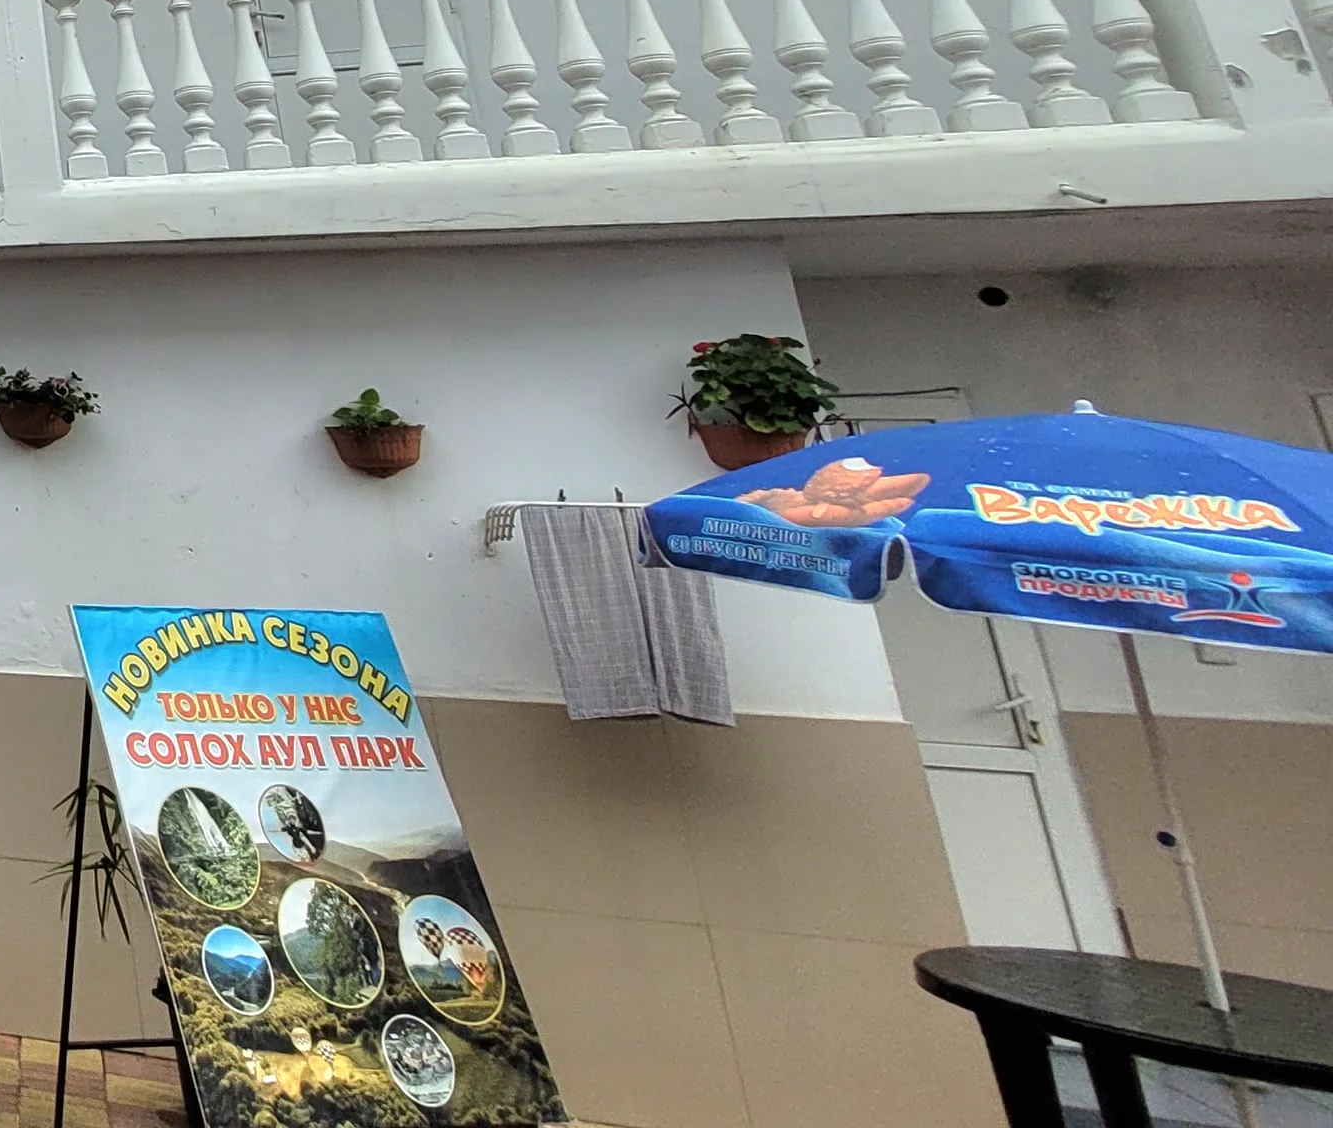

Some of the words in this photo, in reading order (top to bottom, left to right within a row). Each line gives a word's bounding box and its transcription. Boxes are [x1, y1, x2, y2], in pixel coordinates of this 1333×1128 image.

[966, 483, 1301, 536] Варежка
[693, 537, 765, 563] ВКУСОМ
[1011, 562, 1186, 592] ЗДОРОВЫЕ
[1017, 578, 1188, 608] ПРОДУКТЫ
[101, 609, 257, 714] НОВИНКА
[260, 615, 415, 724] СЕЗОНА
[156, 691, 276, 722] ТОЛЬКО
[276, 694, 298, 722] У
[302, 694, 363, 724] НАС
[125, 731, 254, 768] СОЛОХ
[256, 733, 326, 769] АУЛ
[329, 734, 428, 771] ПАРК
